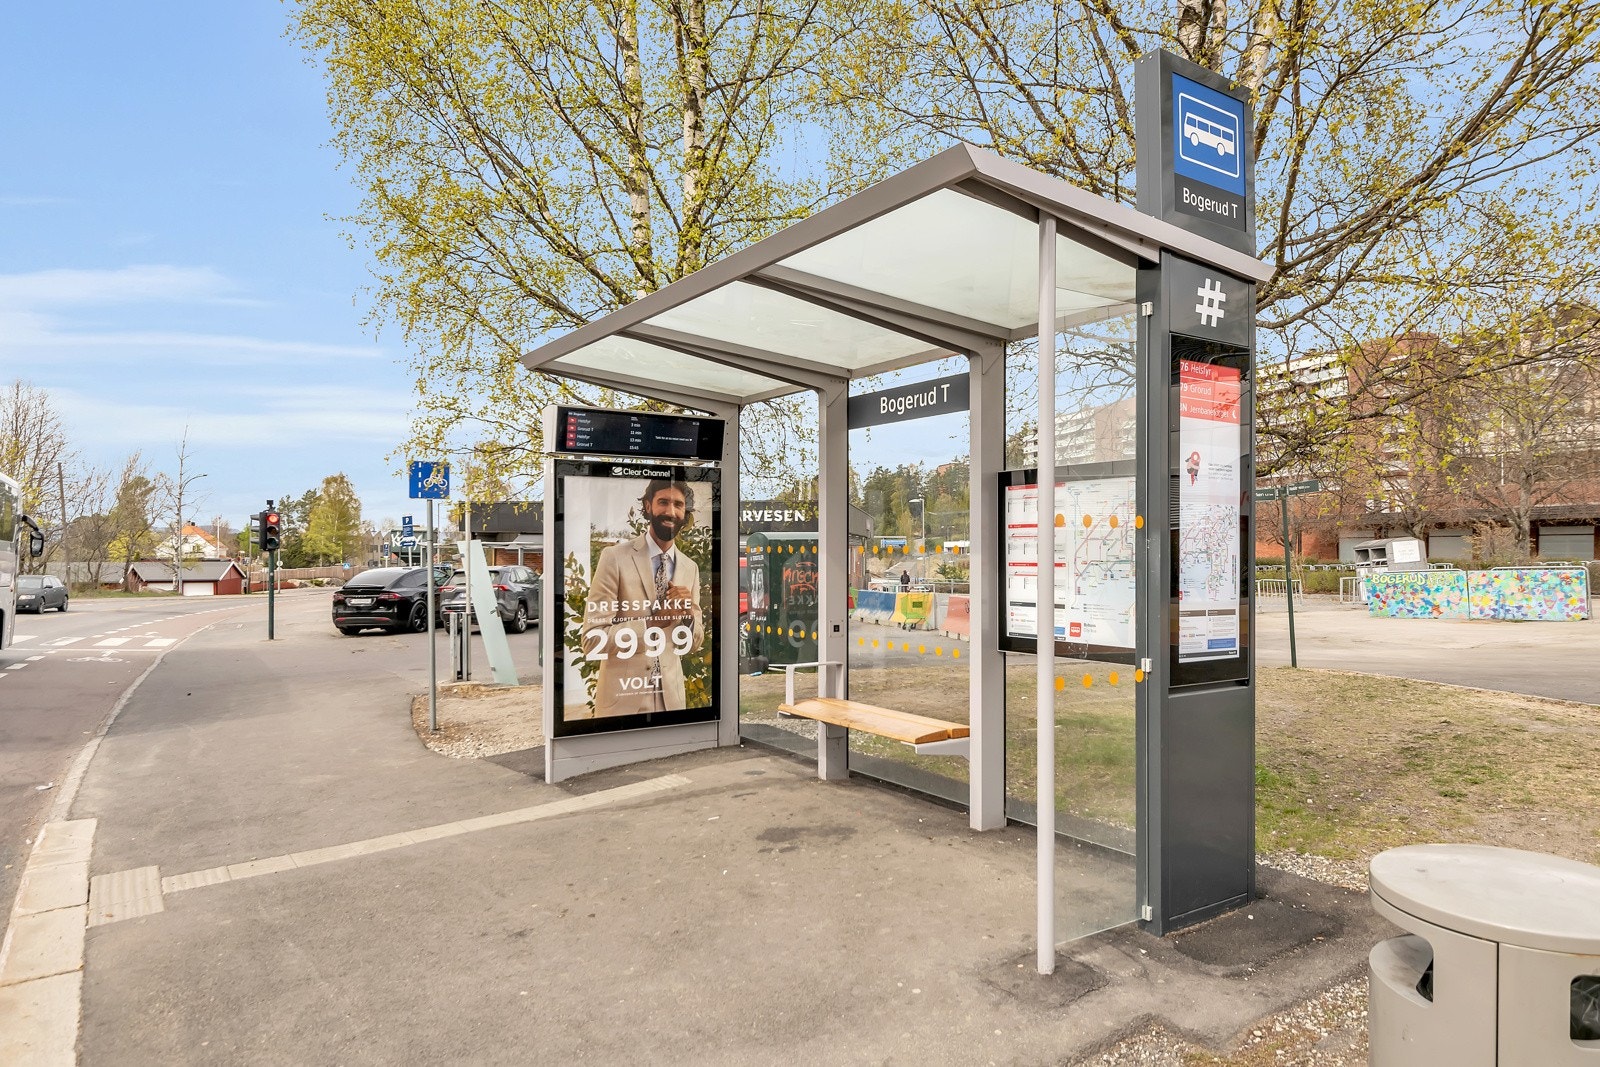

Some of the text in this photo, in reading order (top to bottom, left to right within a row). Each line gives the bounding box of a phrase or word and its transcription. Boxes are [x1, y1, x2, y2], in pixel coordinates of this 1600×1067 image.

[1183, 187, 1238, 219] Bogerud T
[1180, 361, 1212, 377] 76 Helsfyr
[1180, 382, 1212, 396] 79 Grorud
[880, 383, 951, 415] Bogerud T
[623, 467, 671, 477] Clear Channel
[739, 509, 806, 522] RVESEN
[1371, 573, 1425, 585] BOGERUD
[587, 598, 692, 613] DRESSPAKKE
[585, 625, 693, 661] 2999
[619, 675, 663, 690] VOLT
